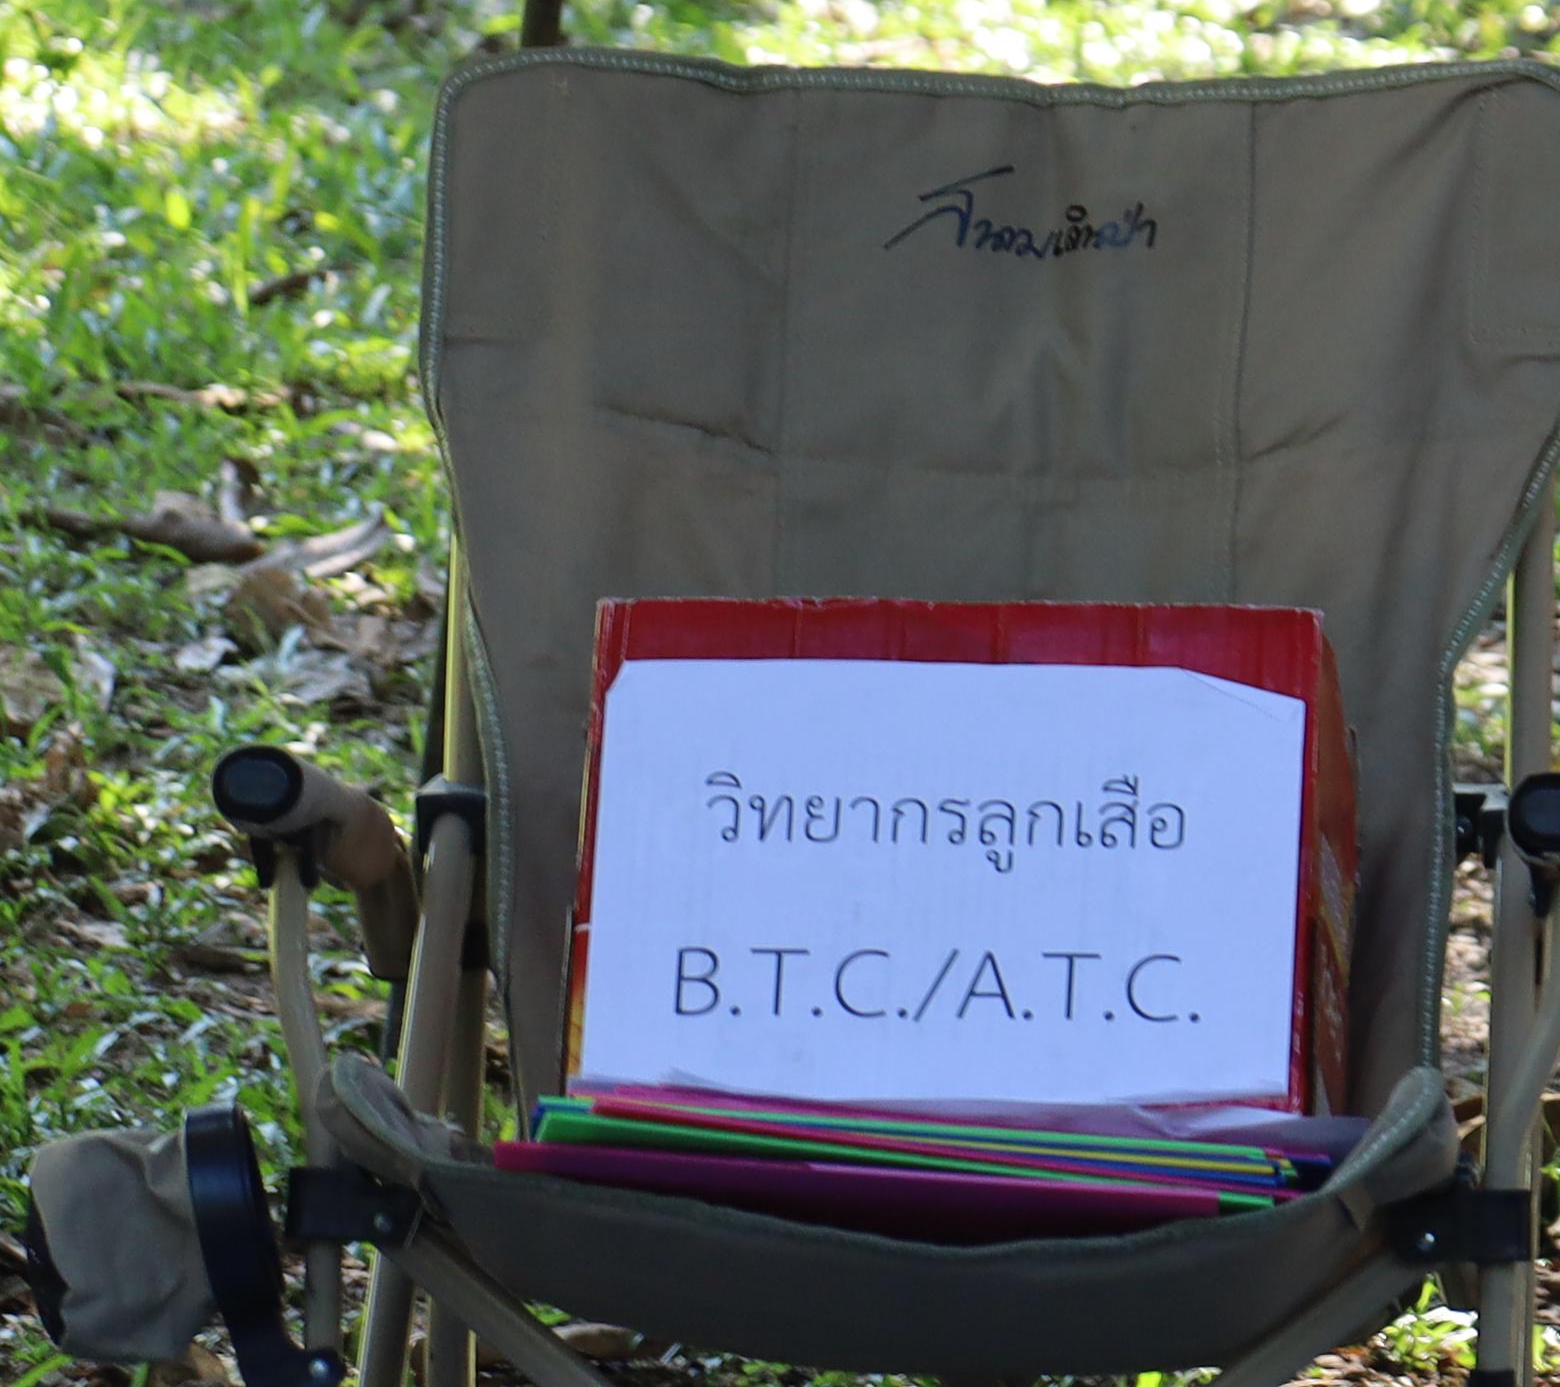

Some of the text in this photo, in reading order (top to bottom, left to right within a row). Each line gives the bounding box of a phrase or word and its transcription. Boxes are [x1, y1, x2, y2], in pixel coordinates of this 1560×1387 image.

[704, 771, 1187, 875] วิทยากรลูกเสือ
[674, 946, 1202, 1024] B.T.C./A.T.C.
